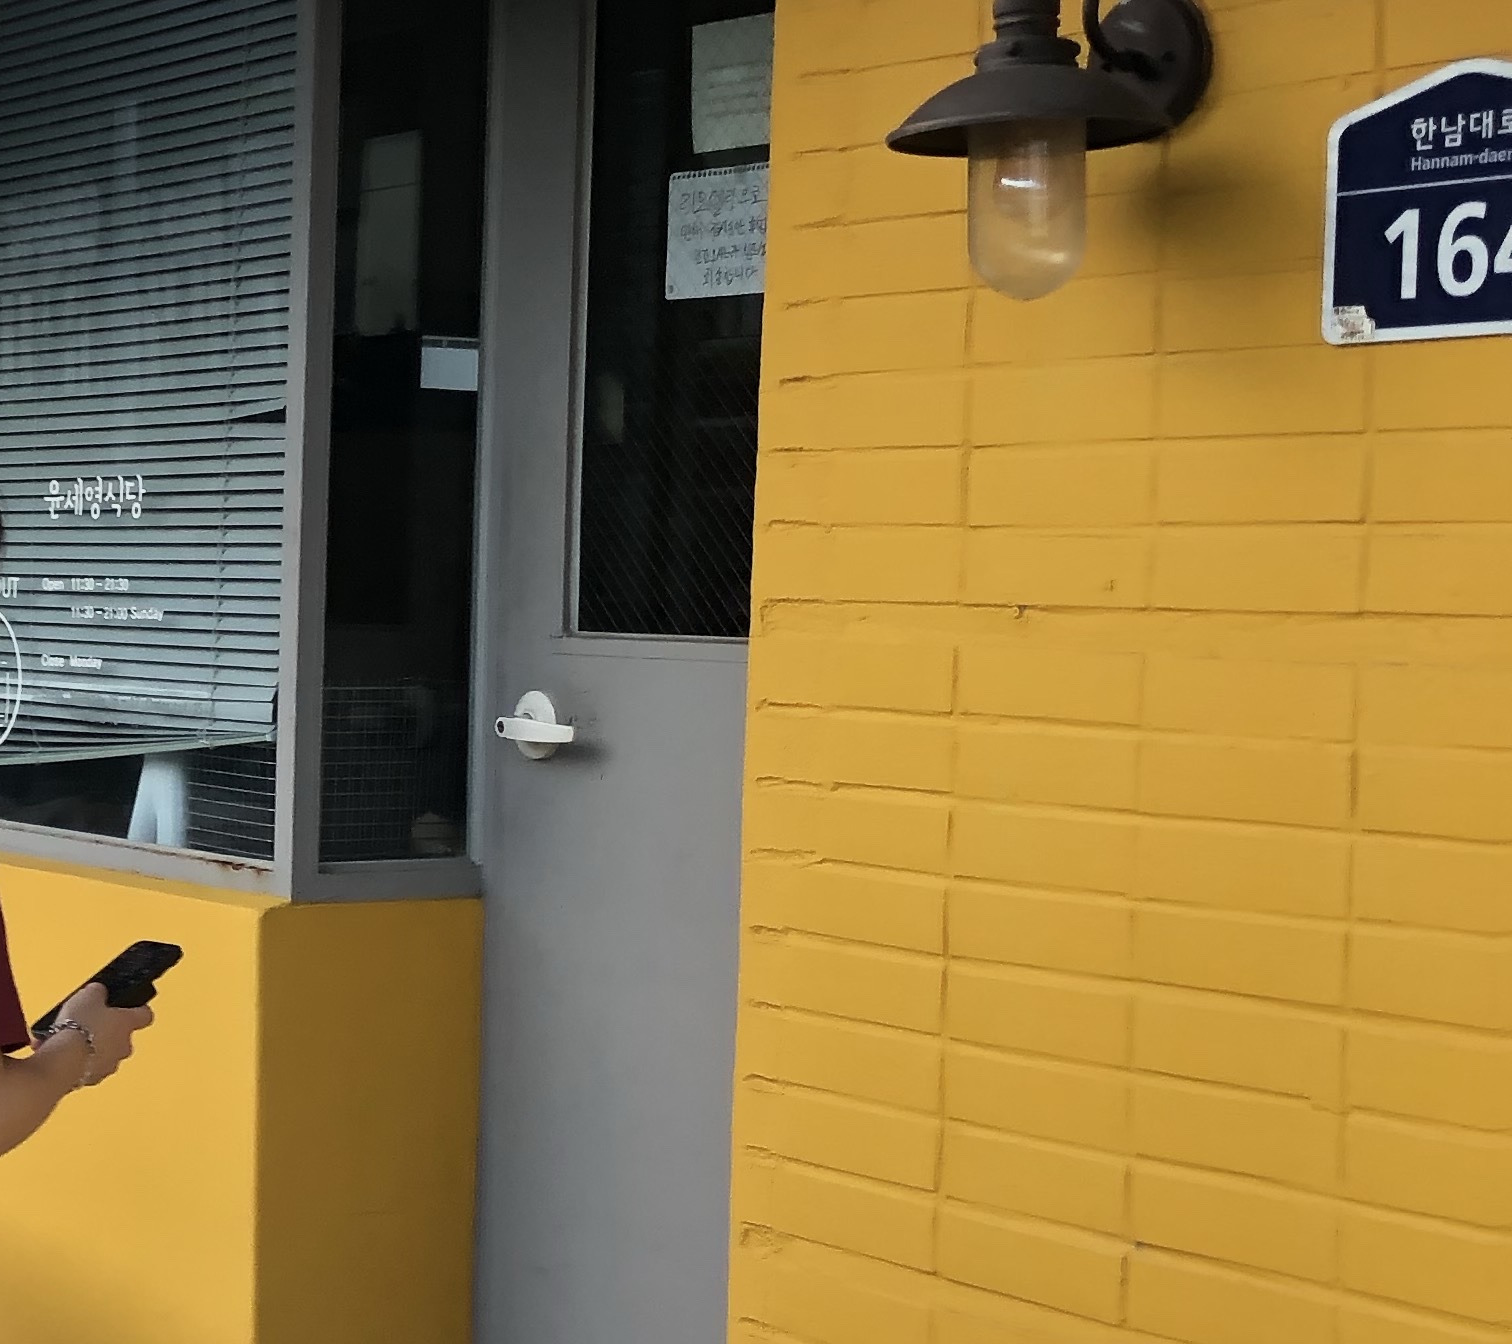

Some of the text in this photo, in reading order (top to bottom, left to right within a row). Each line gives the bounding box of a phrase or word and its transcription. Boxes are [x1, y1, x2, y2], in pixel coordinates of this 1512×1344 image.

[1411, 109, 1512, 151] 한남대로
[44, 474, 147, 520] 윤세영식당
[41, 577, 65, 591] Open
[129, 606, 164, 621] Sunday
[40, 654, 103, 669] Close Monday
